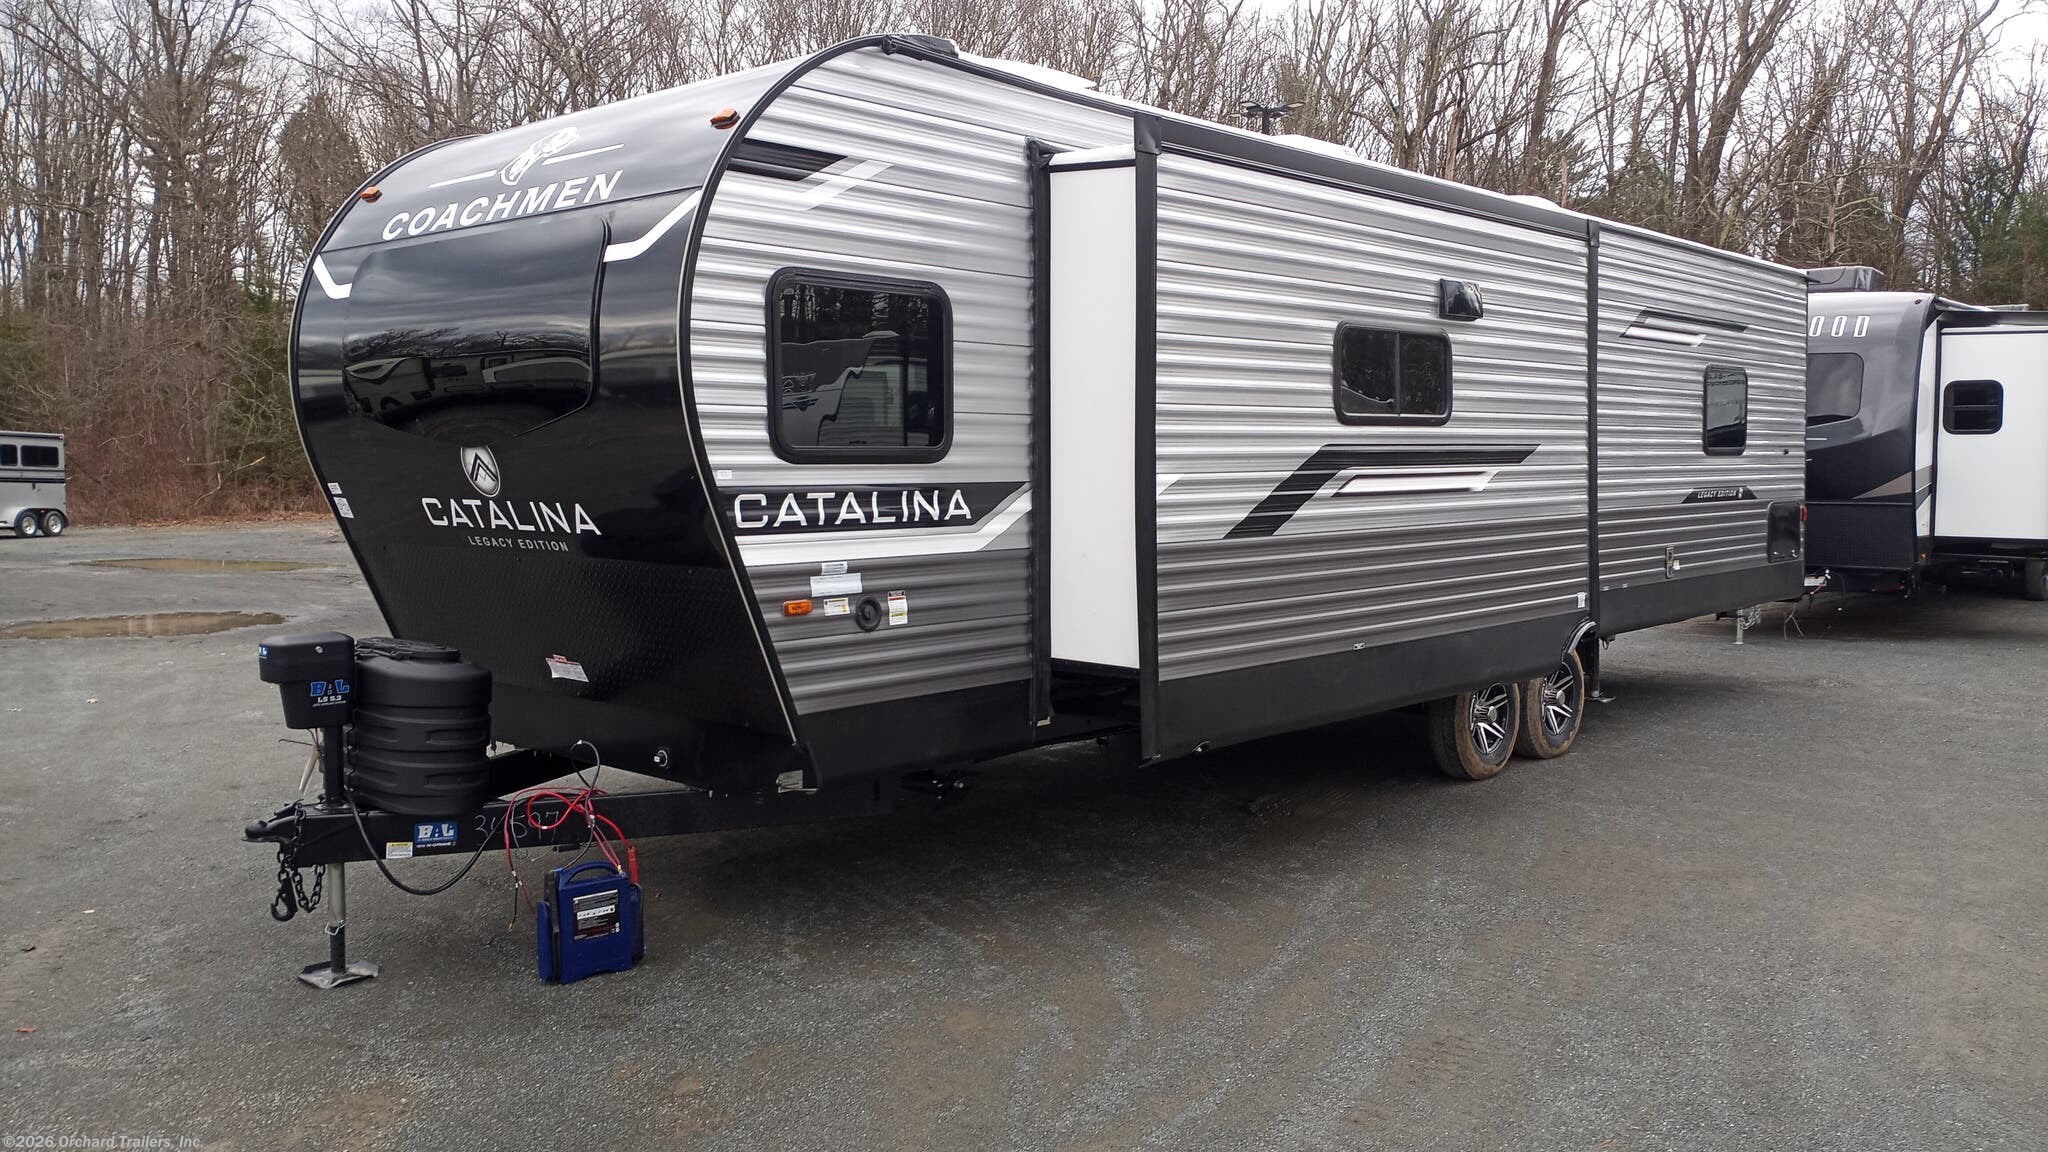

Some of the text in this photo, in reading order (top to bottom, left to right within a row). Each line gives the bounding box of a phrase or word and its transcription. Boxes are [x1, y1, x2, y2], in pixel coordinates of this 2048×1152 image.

[382, 169, 623, 240] COACHMEN
[421, 497, 602, 535] CATALINA
[734, 489, 972, 528] CATALINA
[467, 535, 569, 552] LEGACY EDITION
